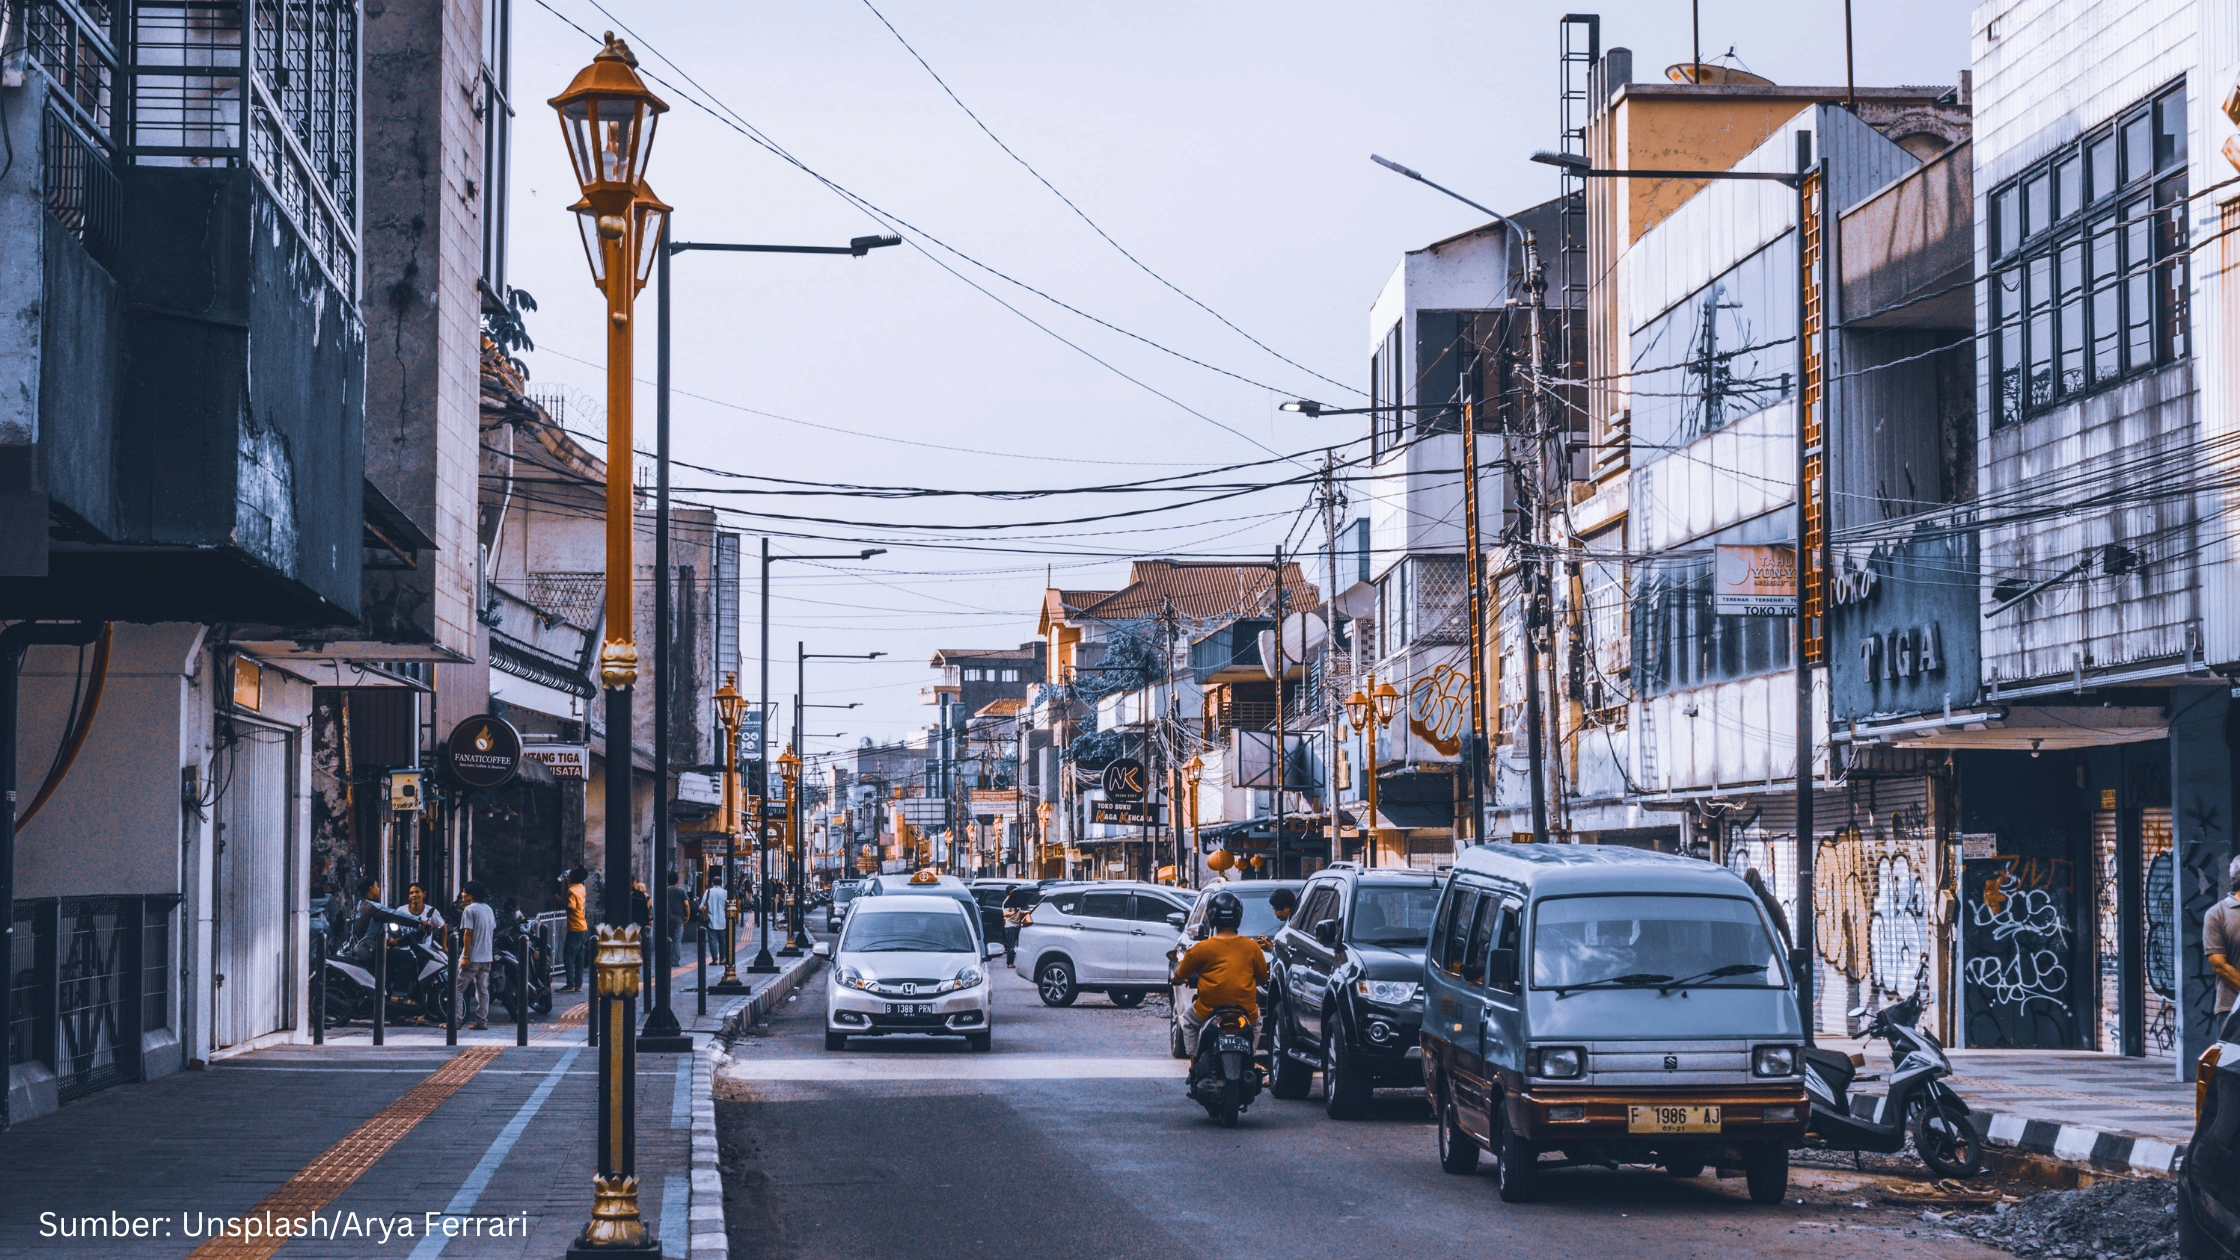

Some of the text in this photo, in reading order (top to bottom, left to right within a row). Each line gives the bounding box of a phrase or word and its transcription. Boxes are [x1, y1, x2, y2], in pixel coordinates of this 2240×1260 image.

[1760, 556, 1793, 567] TAHU
[1751, 568, 1796, 579] YUN-Y
[1829, 567, 1872, 608] TOKO
[1744, 606, 1775, 616] TOKO
[1860, 621, 1942, 683] TIGA
[454, 753, 511, 765] FANATICOFFEE
[557, 752, 580, 763] TIGA
[550, 766, 581, 776] ISATA
[1109, 766, 1142, 792] NK
[1097, 802, 1114, 810] TOKO
[1096, 809, 1117, 823] NAGA
[886, 1004, 932, 1013] B 1388 PRN
[1630, 1107, 1720, 1124] F 1986 AJ
